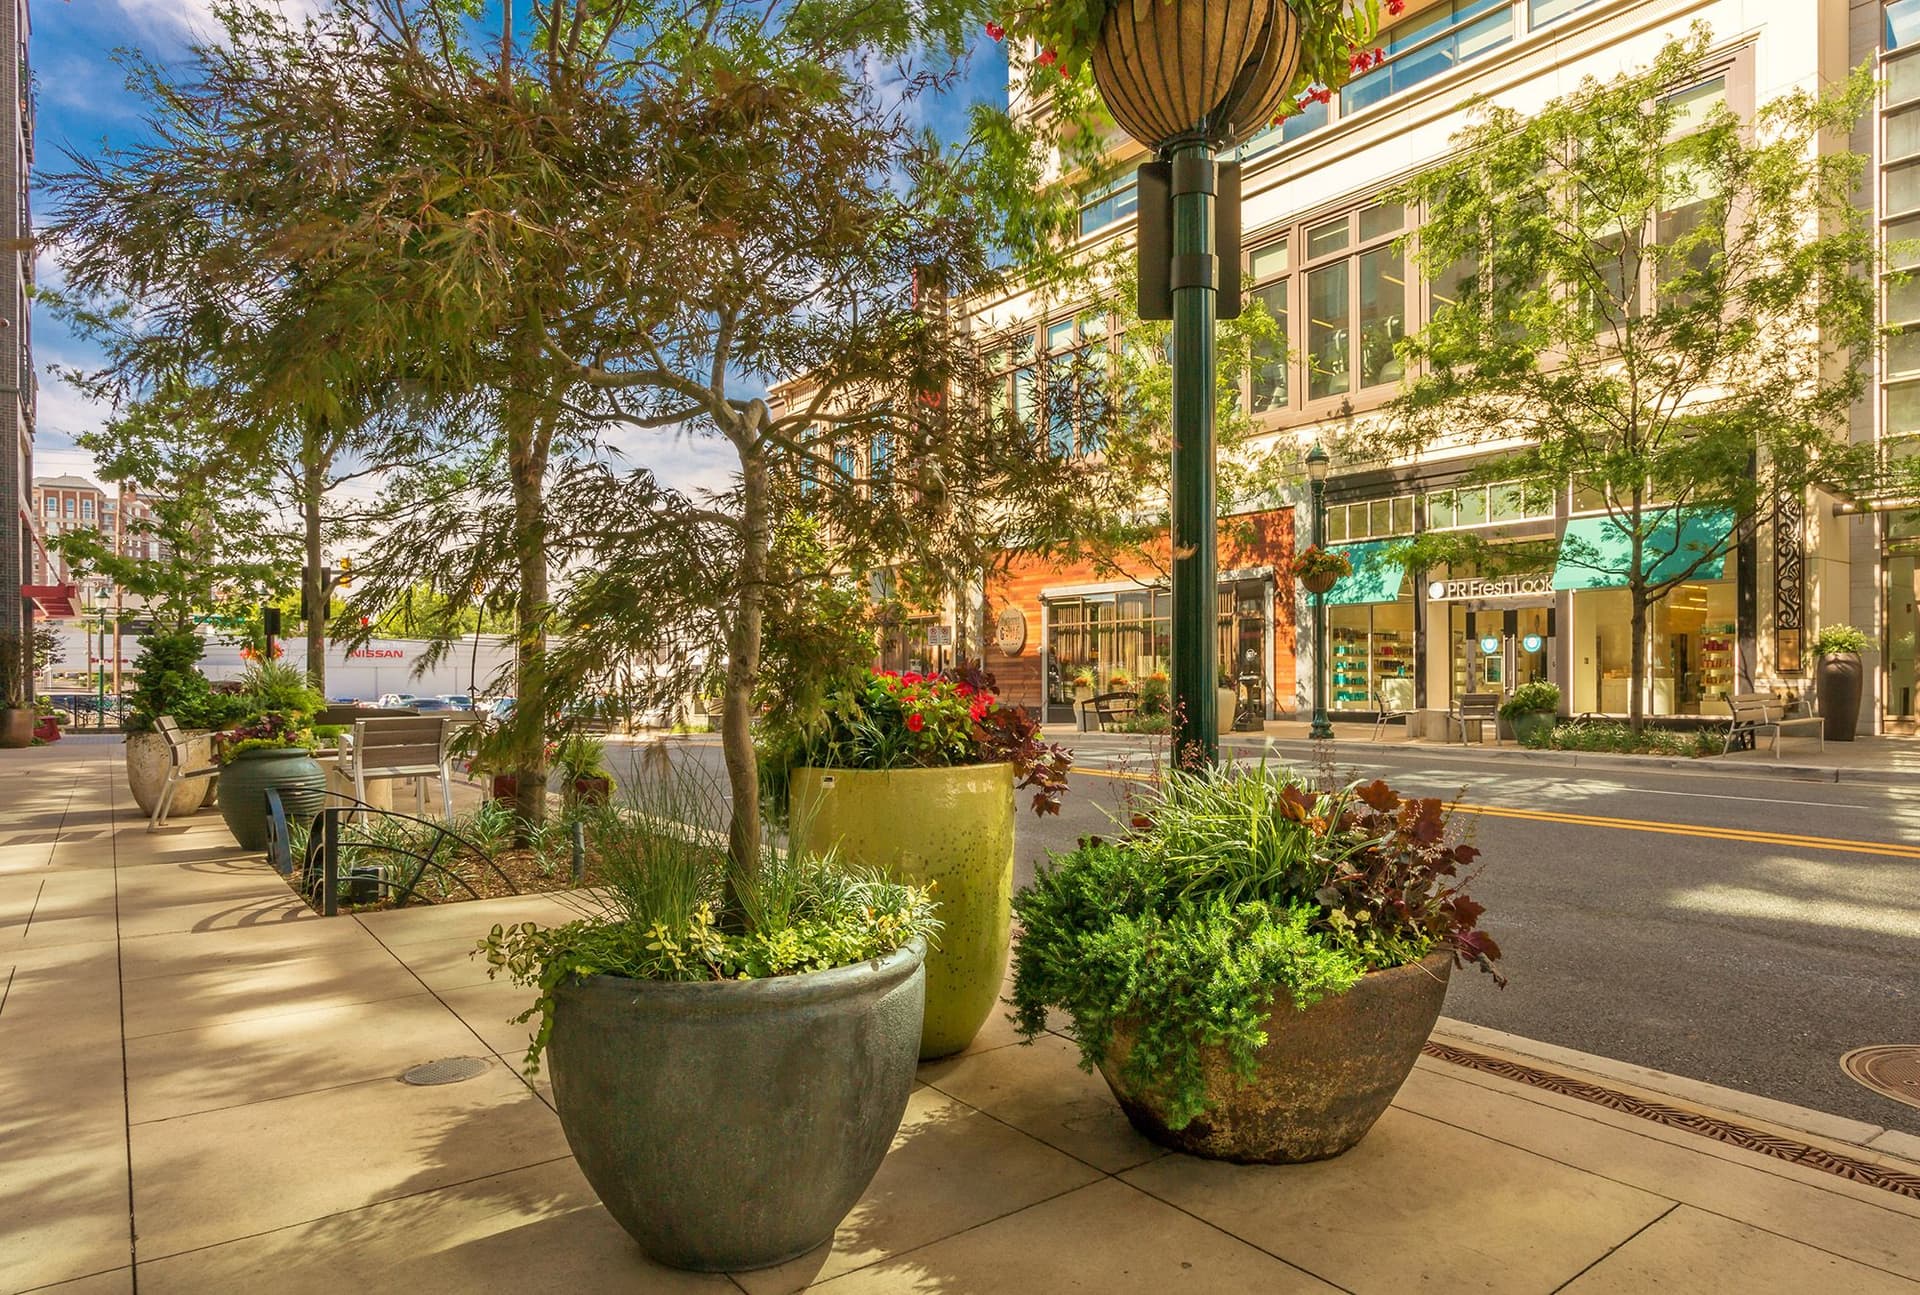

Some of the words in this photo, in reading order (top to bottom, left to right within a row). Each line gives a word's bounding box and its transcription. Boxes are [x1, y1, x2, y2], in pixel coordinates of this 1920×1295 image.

[1448, 582, 1466, 597] PR
[1470, 580, 1512, 596] Fresh
[1515, 576, 1554, 593] Look
[351, 649, 404, 658] NISSAN
